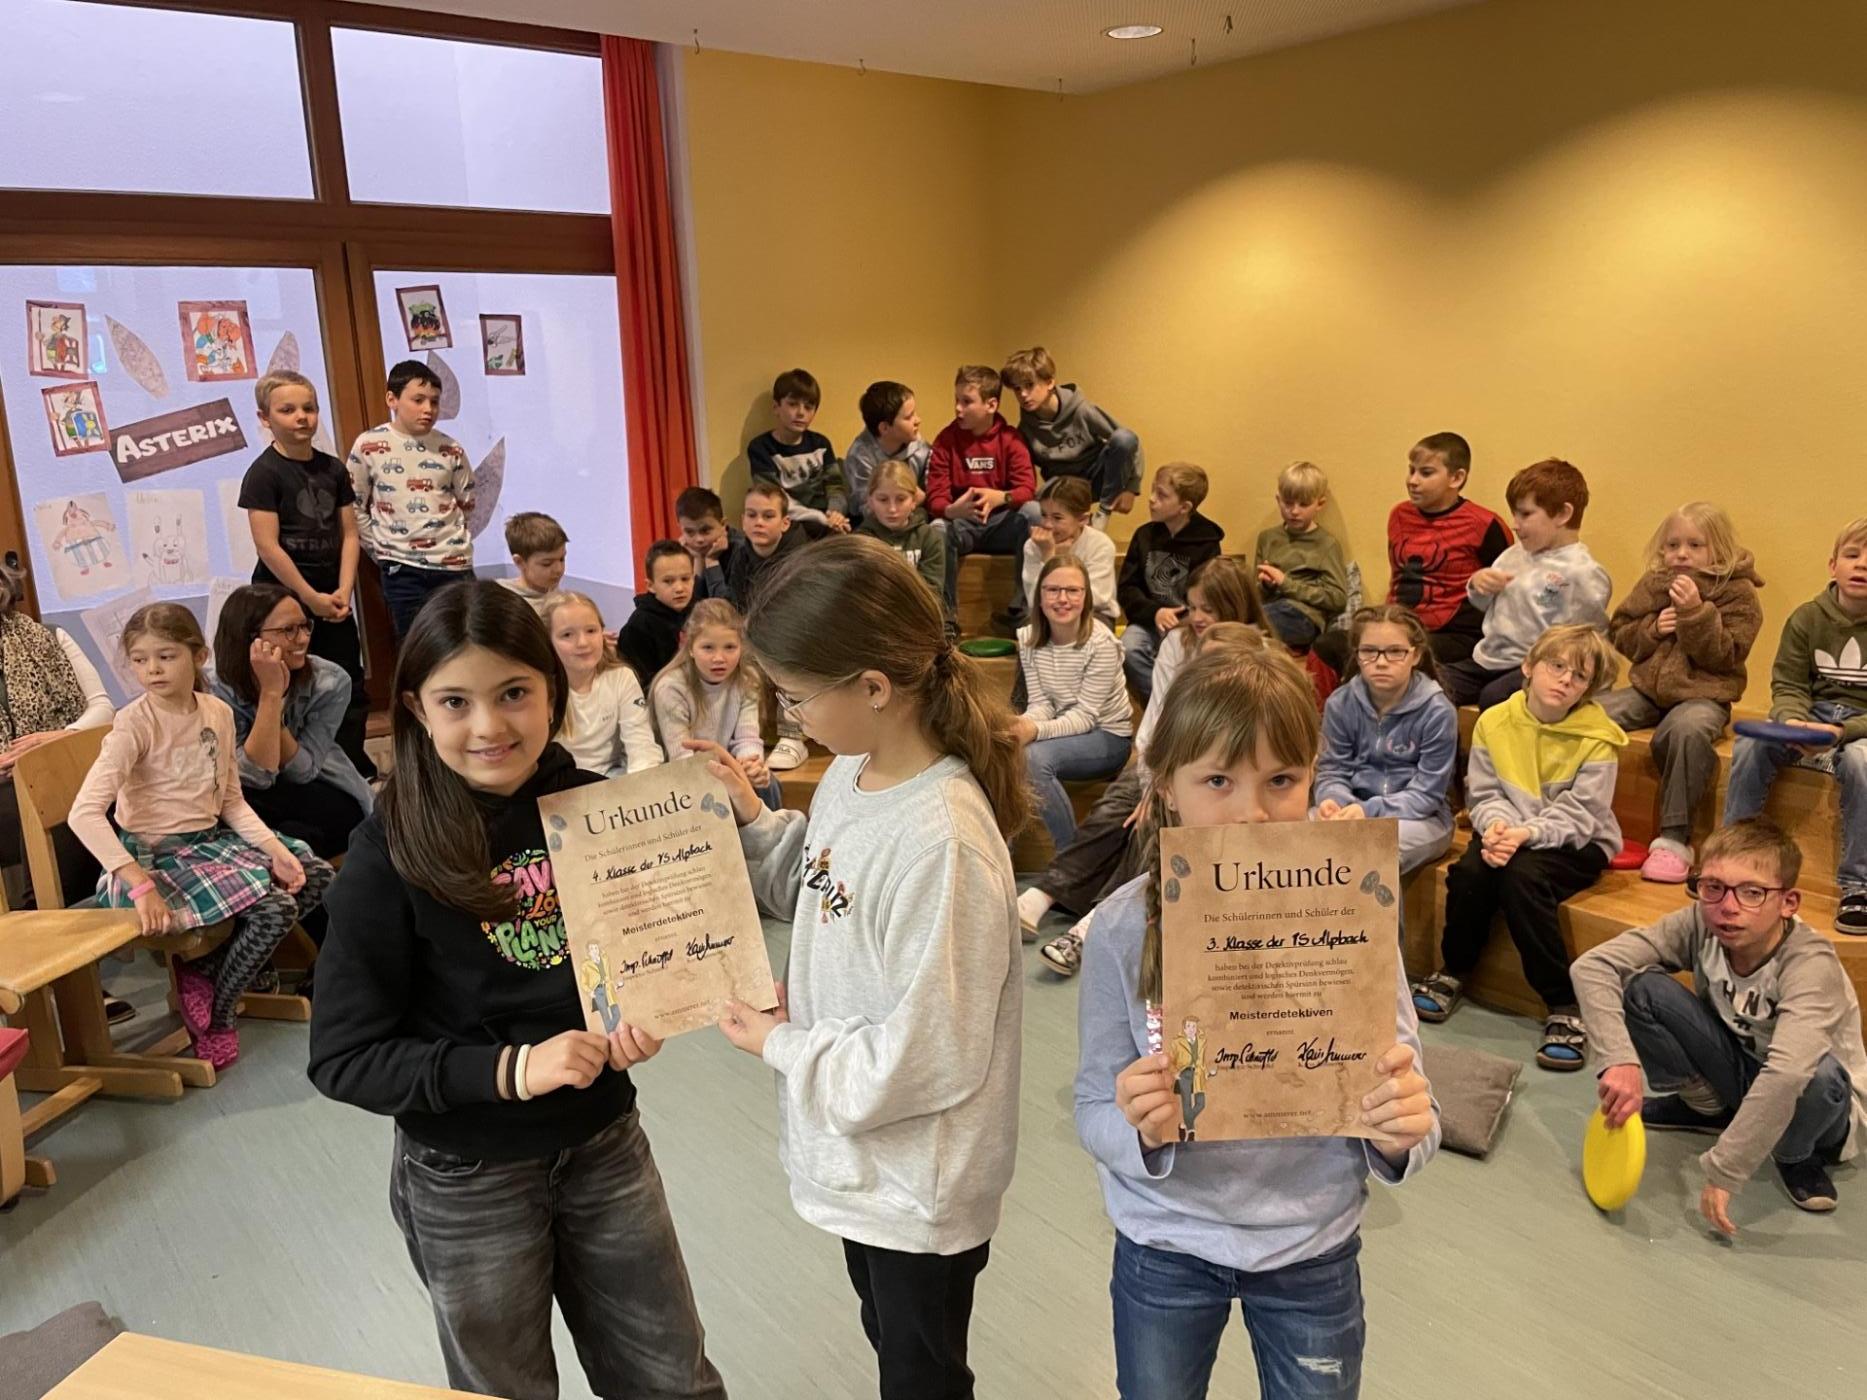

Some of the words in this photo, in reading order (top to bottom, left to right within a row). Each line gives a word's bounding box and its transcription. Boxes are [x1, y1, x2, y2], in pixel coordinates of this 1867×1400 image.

[116, 416, 237, 463] ASTERIX
[1057, 432, 1086, 452] FOX
[965, 456, 995, 470] VANS
[584, 791, 693, 835] Urkunde
[606, 865, 637, 880] Klasse
[672, 841, 712, 862] Alpbach
[1213, 857, 1352, 892] Urkunde
[622, 908, 705, 936] Meisterdetektiven
[1204, 914, 1220, 923] Die
[1222, 910, 1282, 923] Schülerinnen
[1284, 908, 1303, 919] und
[1304, 907, 1339, 918] Schüler
[1340, 905, 1356, 915] der
[1206, 937, 1220, 951] 3.
[1223, 935, 1264, 951] Klasse
[1266, 934, 1285, 947] der
[1311, 929, 1369, 950] Alpbach
[1229, 1007, 1333, 1020] Meisterdetektiven
